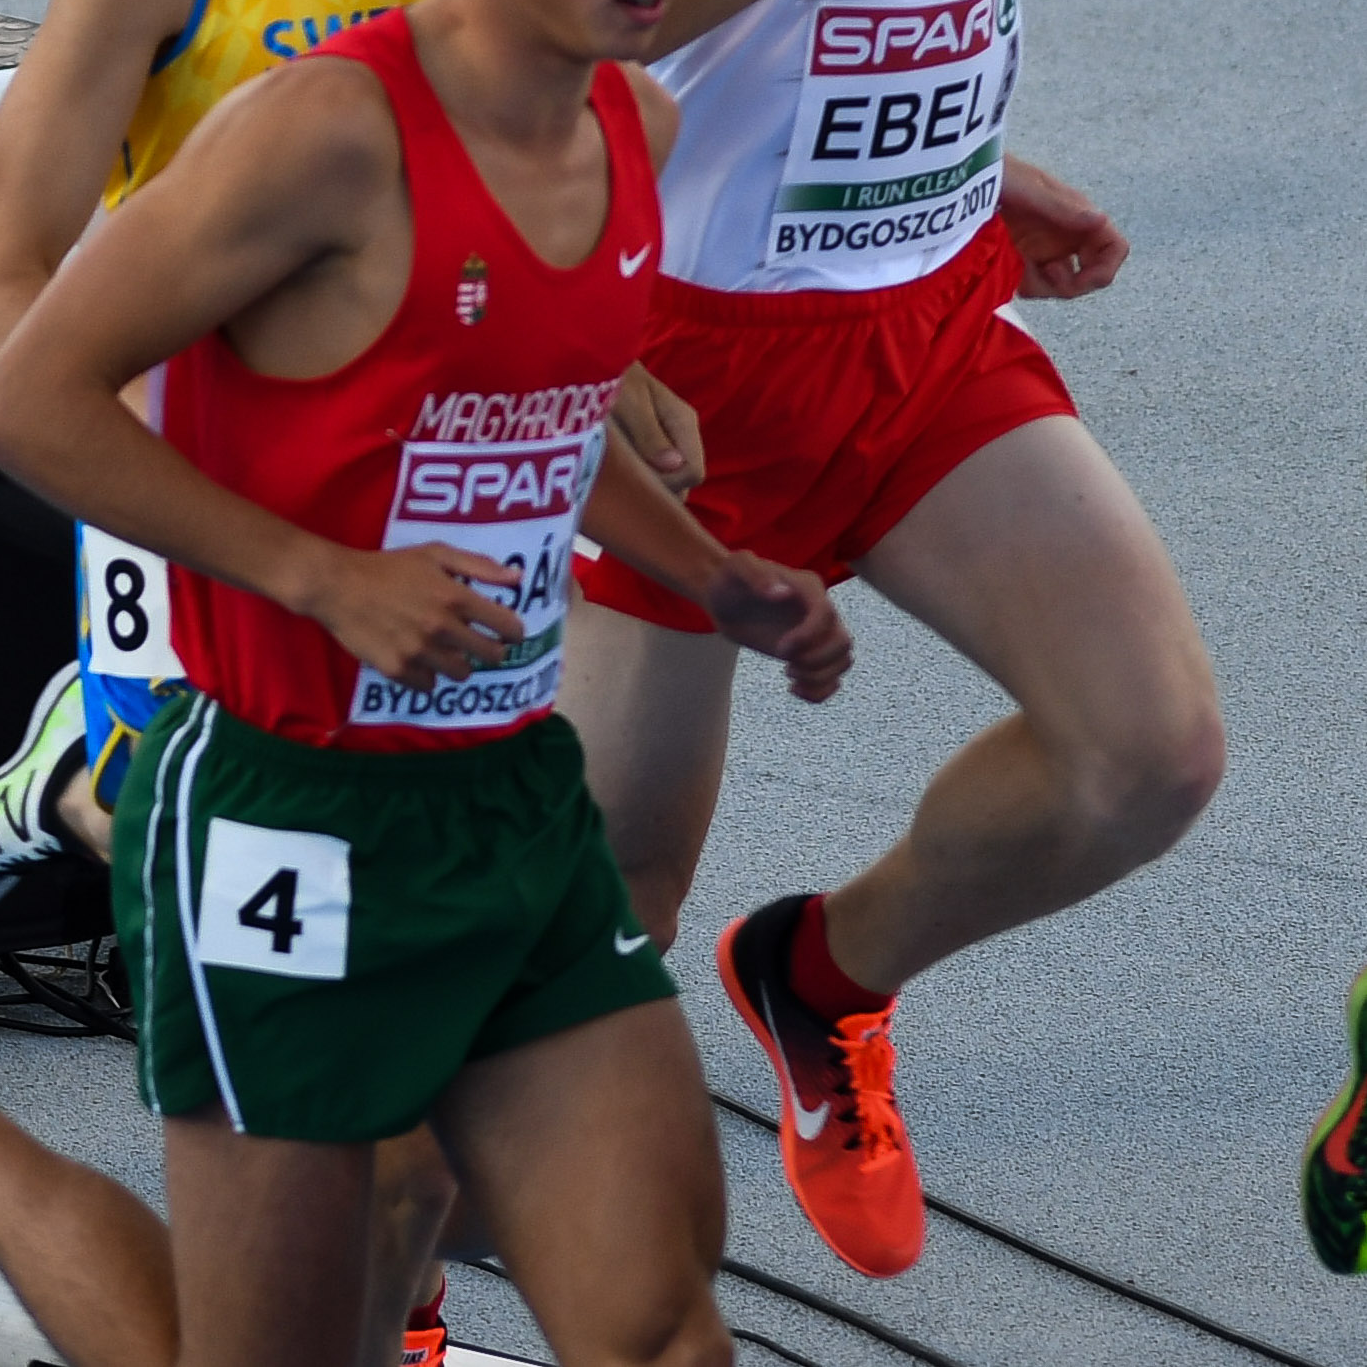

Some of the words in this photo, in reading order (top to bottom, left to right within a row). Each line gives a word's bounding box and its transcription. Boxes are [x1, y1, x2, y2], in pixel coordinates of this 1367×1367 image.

[811, 72, 985, 161] EBEL
[776, 200, 958, 254] BYDGOSZCZ
[959, 175, 997, 222] 2017
[842, 187, 852, 208] I
[856, 183, 907, 208] RUN
[405, 454, 578, 515] SPAR
[104, 558, 148, 652] 8
[237, 868, 303, 954] 4
